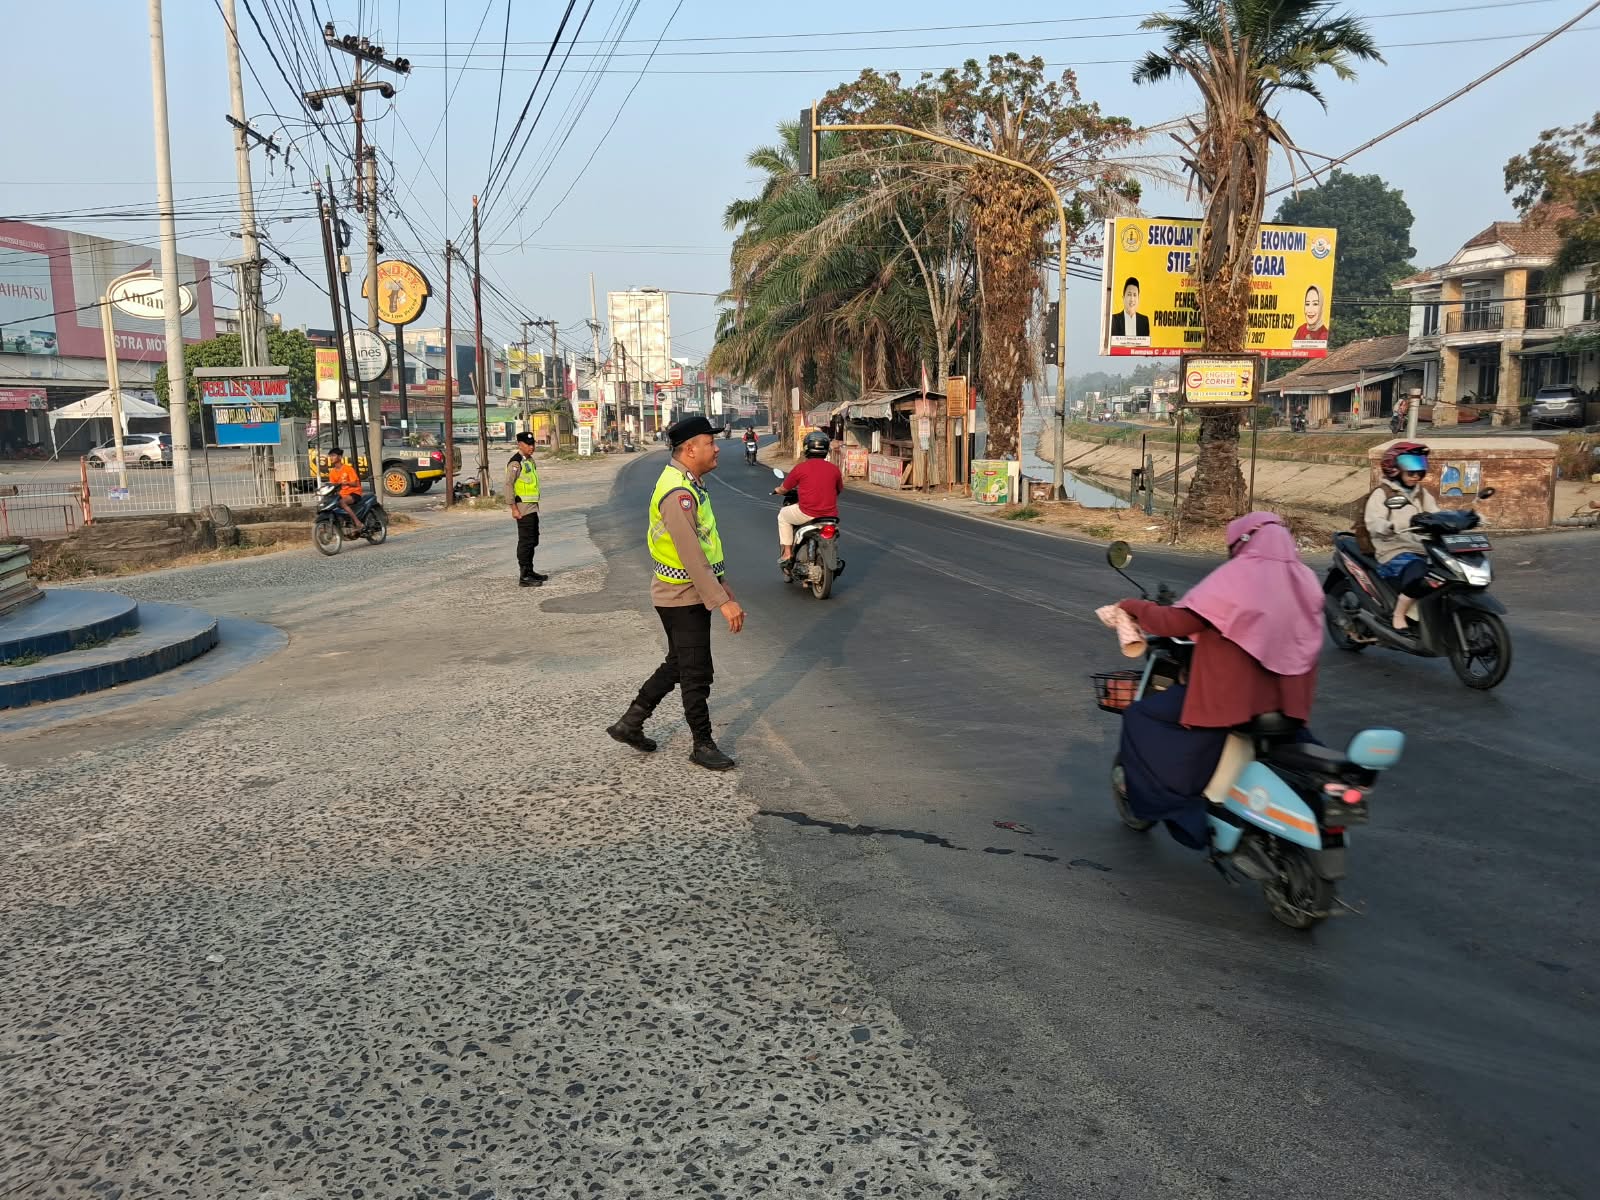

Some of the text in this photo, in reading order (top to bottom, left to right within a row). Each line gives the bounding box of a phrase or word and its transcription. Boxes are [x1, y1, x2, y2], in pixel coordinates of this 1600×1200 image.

[1148, 225, 1193, 246] SEKOLAH
[1261, 231, 1306, 251] EKONOMI
[1167, 251, 1191, 272] STIE
[1252, 255, 1285, 275] GARA
[0, 283, 48, 301] AIHATSU
[122, 288, 165, 310] Aman
[1175, 292, 1197, 308] PENER
[1260, 295, 1278, 310] BARU
[1154, 311, 1187, 327] PROGRAM
[1248, 313, 1280, 329] MAGISTER
[1281, 314, 1295, 329] (S2)
[114, 335, 166, 351] STRA MOT
[1251, 332, 1265, 343] 2027
[202, 381, 228, 397] PECEL
